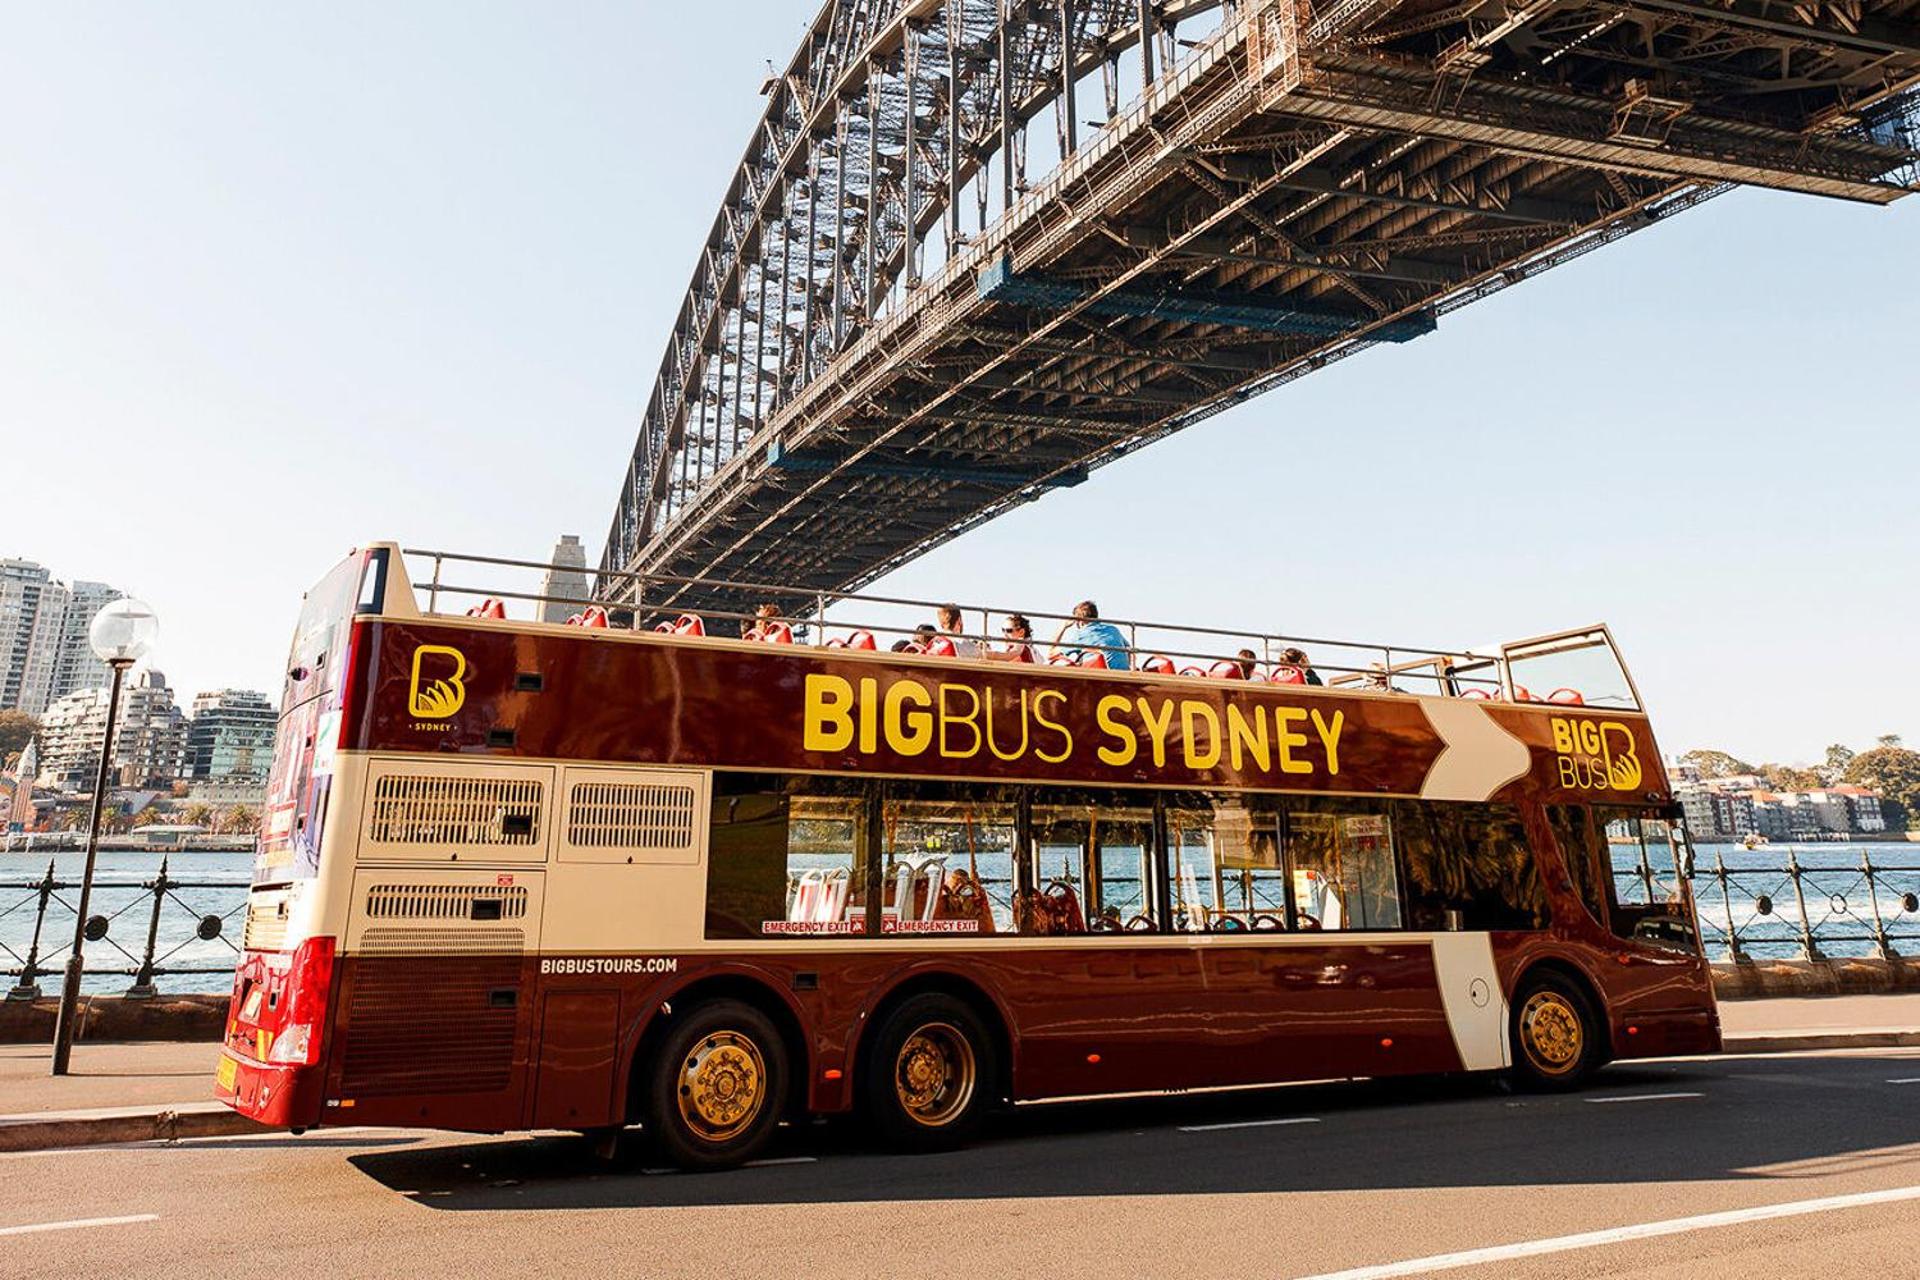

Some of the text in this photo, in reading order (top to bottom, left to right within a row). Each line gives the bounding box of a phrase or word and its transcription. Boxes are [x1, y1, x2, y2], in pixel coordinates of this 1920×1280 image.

[414, 722, 451, 732] SYDNEY
[1096, 694, 1344, 775] SYDNEY
[1551, 718, 1600, 755] BIG
[1558, 756, 1608, 790] BUS
[764, 921, 850, 932] EMERGENCY EXIT
[898, 920, 977, 931] EMERGENCY EXIT
[540, 958, 678, 974] BIGBUSTOURS.COM
